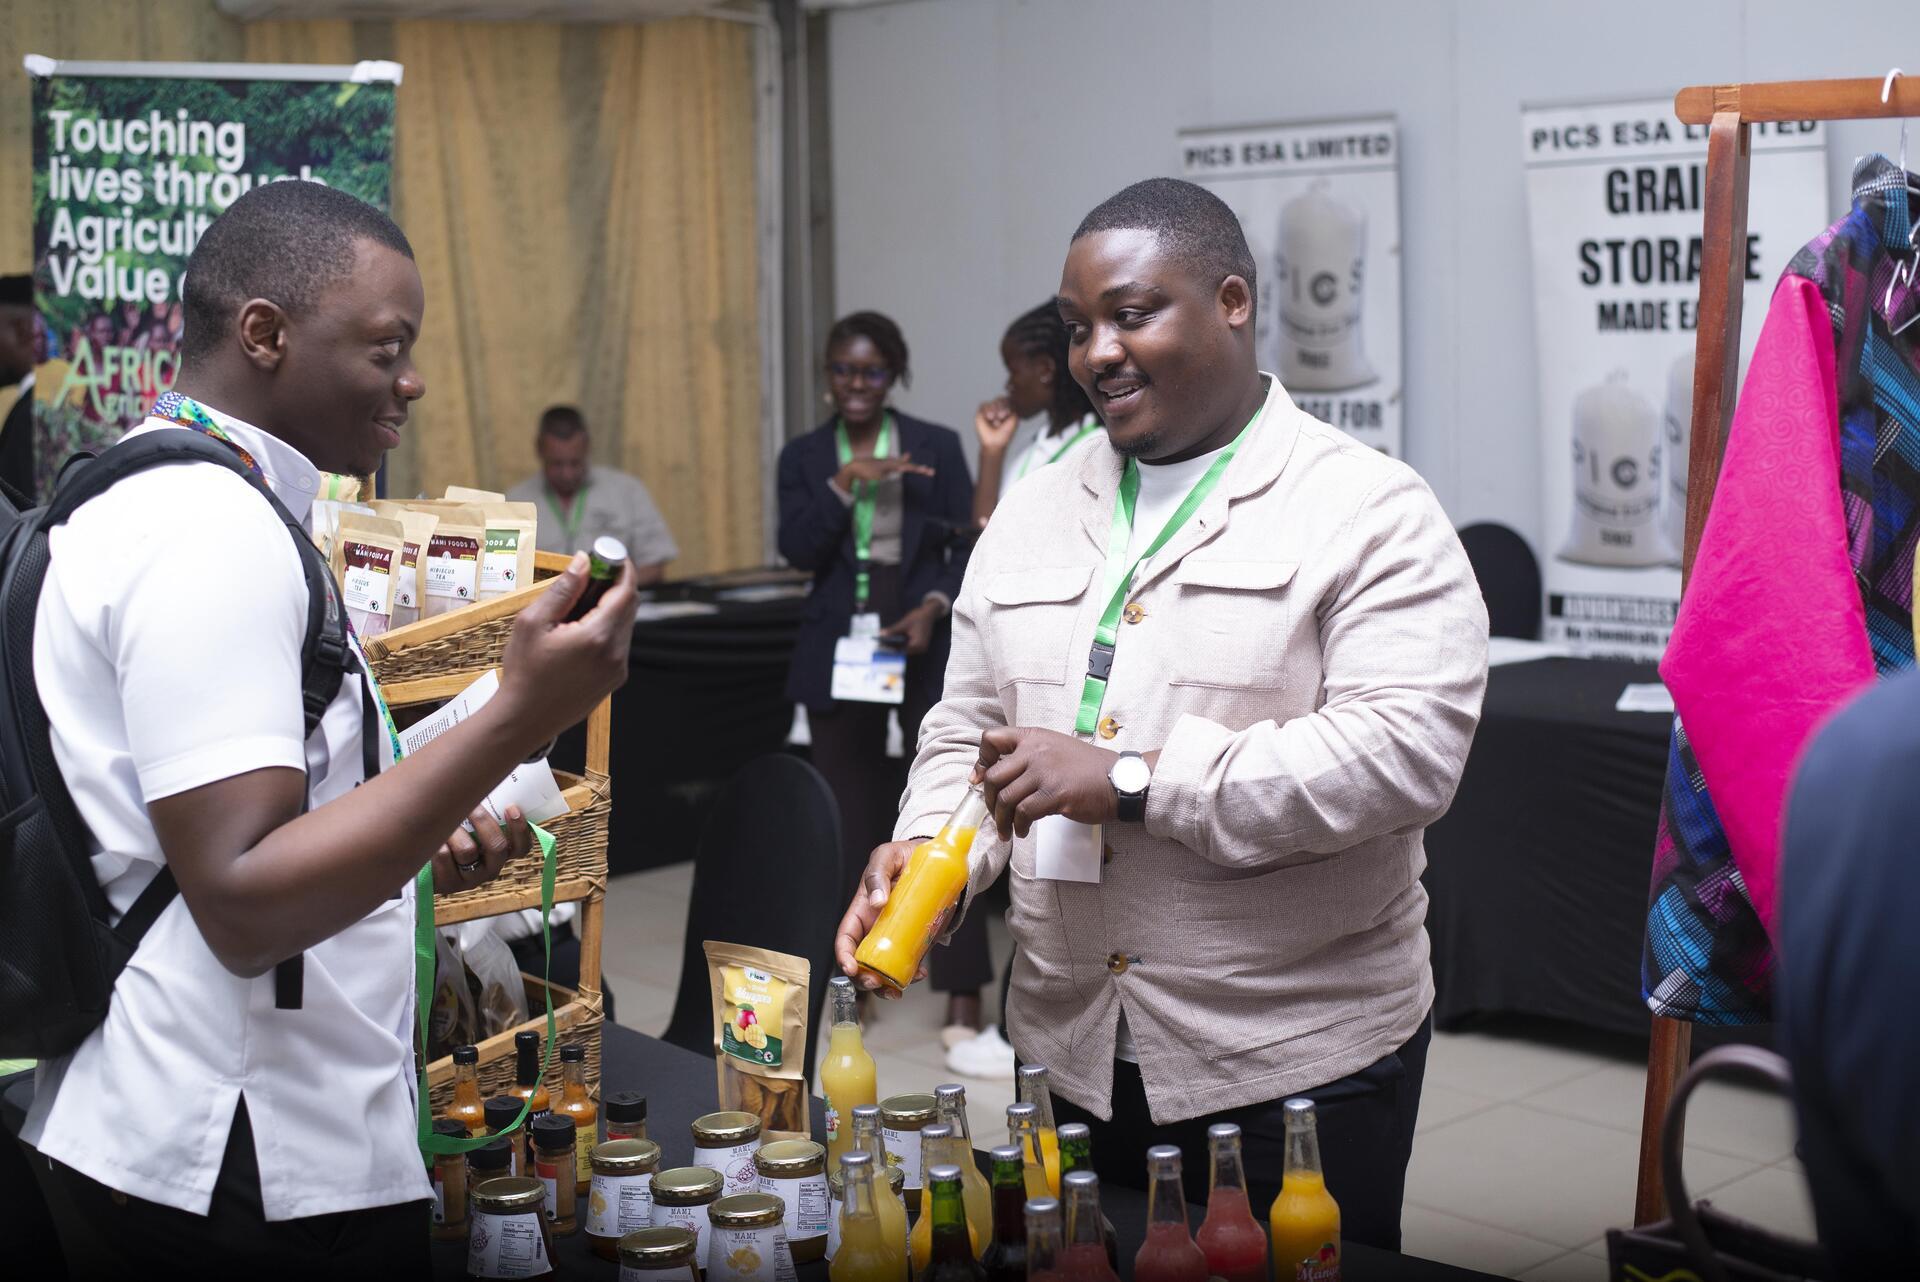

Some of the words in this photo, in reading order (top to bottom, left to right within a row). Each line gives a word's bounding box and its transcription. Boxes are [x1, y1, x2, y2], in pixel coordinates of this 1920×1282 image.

[49, 107, 246, 173] Touching
[1185, 147, 1234, 168] PICS
[1241, 143, 1284, 165] ESA
[1293, 133, 1391, 160] LIMITED
[1531, 124, 1601, 151] PICS
[1612, 120, 1672, 145] ESA
[49, 154, 145, 204] lives
[1605, 165, 1708, 216] GRAI
[1579, 233, 1762, 286] STORAE
[48, 253, 170, 304] Value
[1598, 300, 1670, 331] MADE
[52, 336, 181, 423] AFRIC
[1339, 400, 1383, 429] FOR
[448, 540, 468, 549] FOODS
[430, 567, 455, 575] HIBISCUS
[732, 1144, 751, 1154] MAMI
[884, 1129, 898, 1139] MAMI
[671, 1207, 692, 1216] MAMI
[734, 1232, 757, 1241] MAMI
